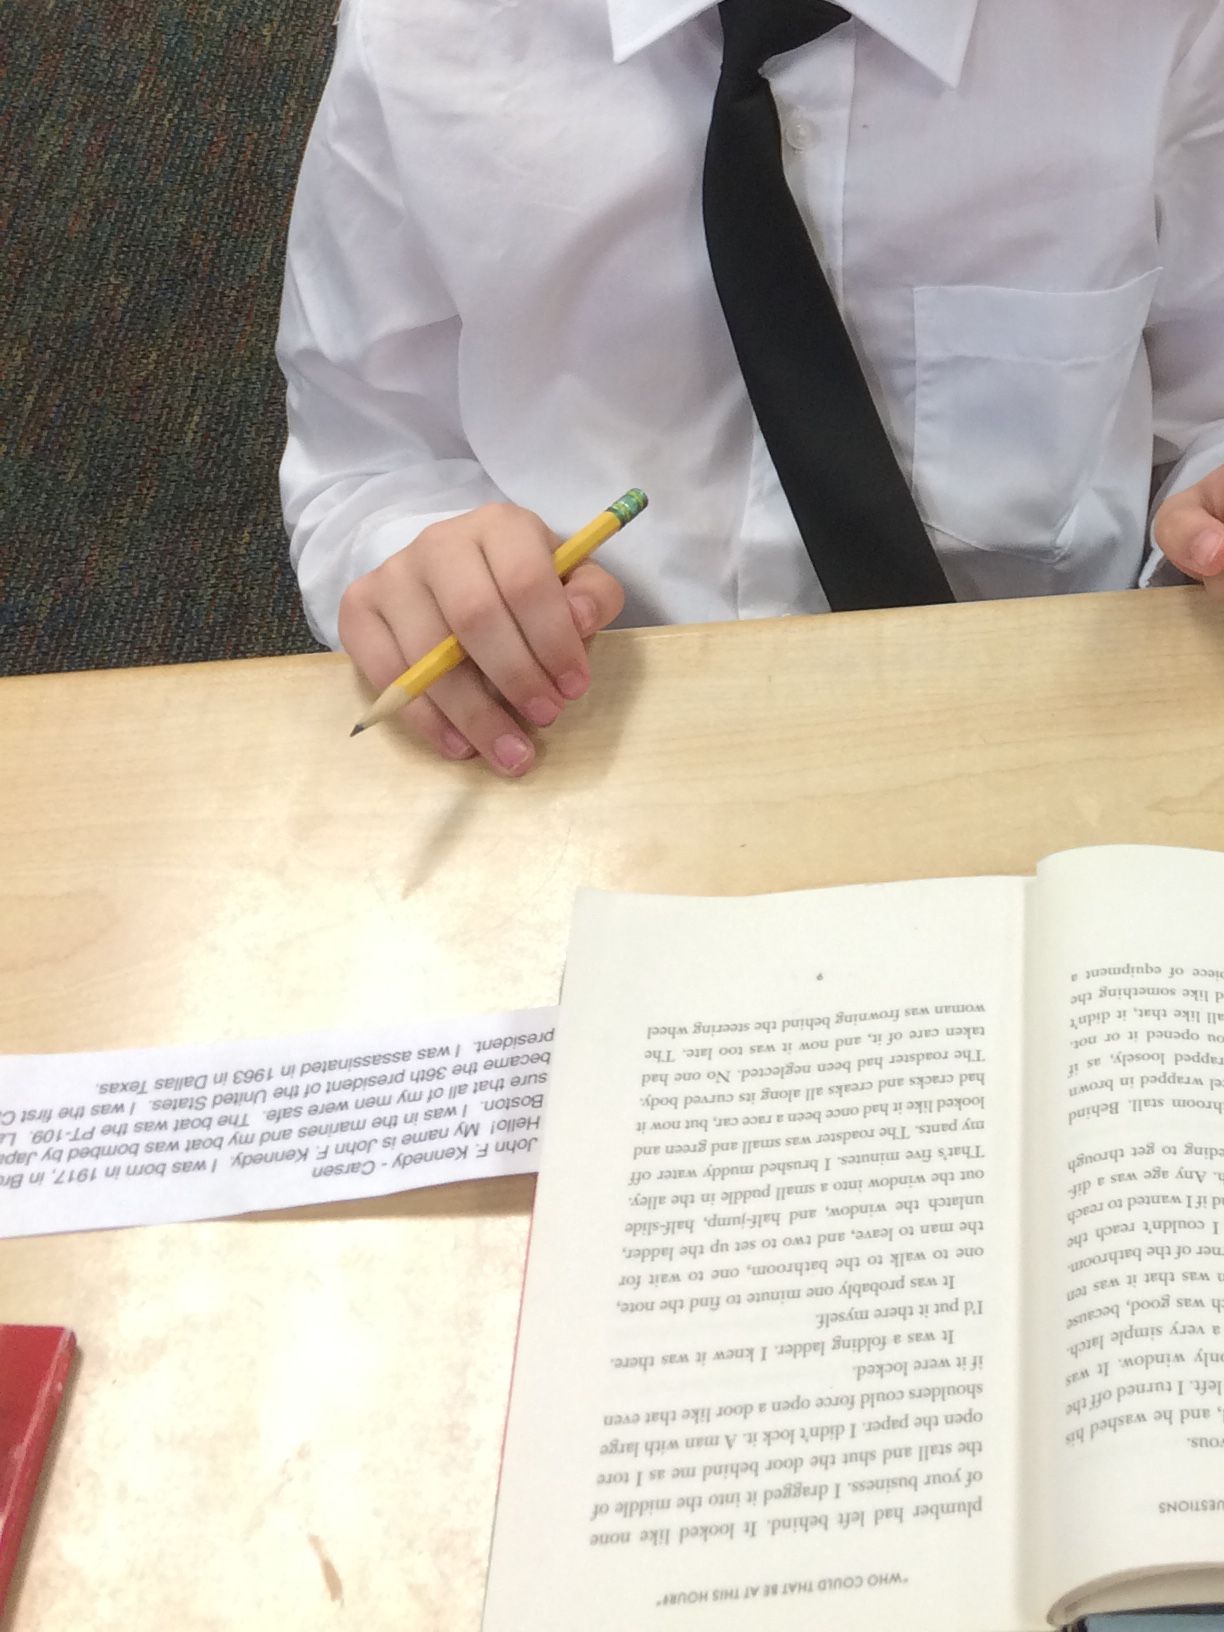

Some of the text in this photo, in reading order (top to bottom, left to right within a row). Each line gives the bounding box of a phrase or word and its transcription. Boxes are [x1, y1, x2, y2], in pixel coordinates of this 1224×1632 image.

[1084, 960, 1164, 982] equipment
[1166, 965, 1186, 980] of
[473, 1028, 556, 1054] president.
[416, 1046, 450, 1060] was
[483, 1051, 551, 1070] became
[280, 1064, 296, 1078] in
[300, 1050, 412, 1077] assassinated
[452, 1062, 478, 1076] the
[641, 1049, 987, 1088] The roadster had been neglected. No one had
[154, 1074, 208, 1091] Dallas
[213, 1072, 228, 1086] in
[232, 1068, 274, 1085] 1963
[325, 1069, 406, 1094] president
[410, 1066, 448, 1084] 36th
[510, 1072, 548, 1087] sure
[96, 1080, 148, 1096] Texas.
[272, 1084, 300, 1100] the
[302, 1082, 322, 1098] of
[448, 1083, 469, 1100] all
[472, 1078, 505, 1094] that
[211, 1088, 267, 1109] United
[354, 1094, 392, 1110] men
[396, 1089, 424, 1104] my
[426, 1087, 444, 1103] of
[480, 1094, 544, 1112] Boston.
[90, 1103, 125, 1116] was
[149, 1096, 208, 1112] States.
[307, 1100, 349, 1116] were
[0, 1110, 16, 1126] C
[20, 1109, 53, 1123] first
[58, 1106, 85, 1120] the
[216, 1113, 250, 1128] The
[263, 1106, 303, 1124] safe.
[403, 1112, 419, 1126] in
[424, 1106, 457, 1121] was
[100, 1122, 128, 1137] the
[133, 1120, 168, 1133] was
[172, 1116, 213, 1132] boat
[298, 1119, 367, 1138] marines
[371, 1114, 398, 1129] the
[453, 1121, 480, 1138] My
[490, 1115, 542, 1135] Hello!
[30, 1126, 96, 1144] PT-109.
[227, 1131, 256, 1146] my
[258, 1128, 293, 1146] and
[382, 1136, 397, 1150] is
[401, 1128, 449, 1146] name
[66, 1142, 140, 1162] bombed
[144, 1140, 180, 1154] was
[184, 1136, 224, 1153] boat
[316, 1145, 330, 1160] F.
[334, 1138, 378, 1156] John
[476, 1143, 489, 1158] F.
[494, 1137, 538, 1154] John
[40, 1147, 64, 1163] by
[231, 1147, 309, 1169] Kennedy.
[391, 1145, 469, 1170] Kennedy
[104, 1166, 121, 1180] in
[125, 1162, 167, 1178] born
[171, 1160, 206, 1174] was
[312, 1160, 376, 1178] Carsen
[28, 1172, 45, 1186] in
[52, 1168, 96, 1184] 1917,
[1152, 1409, 1174, 1427] he
[1179, 1407, 1211, 1425] and
[1089, 1412, 1148, 1441] washed
[1065, 1426, 1085, 1447] his
[847, 1475, 919, 1493] business.
[923, 1467, 962, 1486] your
[963, 1469, 985, 1490] of
[707, 1491, 741, 1508] into
[746, 1490, 758, 1506] it
[763, 1481, 829, 1507] dragged
[614, 1498, 671, 1519] middle
[676, 1495, 703, 1513] the
[588, 1502, 611, 1523] of
[589, 1495, 983, 1547] plumber had left behind. It looked like none
[762, 1583, 779, 1598] BE
[781, 1580, 814, 1596] THAT
[816, 1575, 865, 1592] COULD
[711, 1587, 740, 1603] THIS
[743, 1585, 761, 1600] AT
